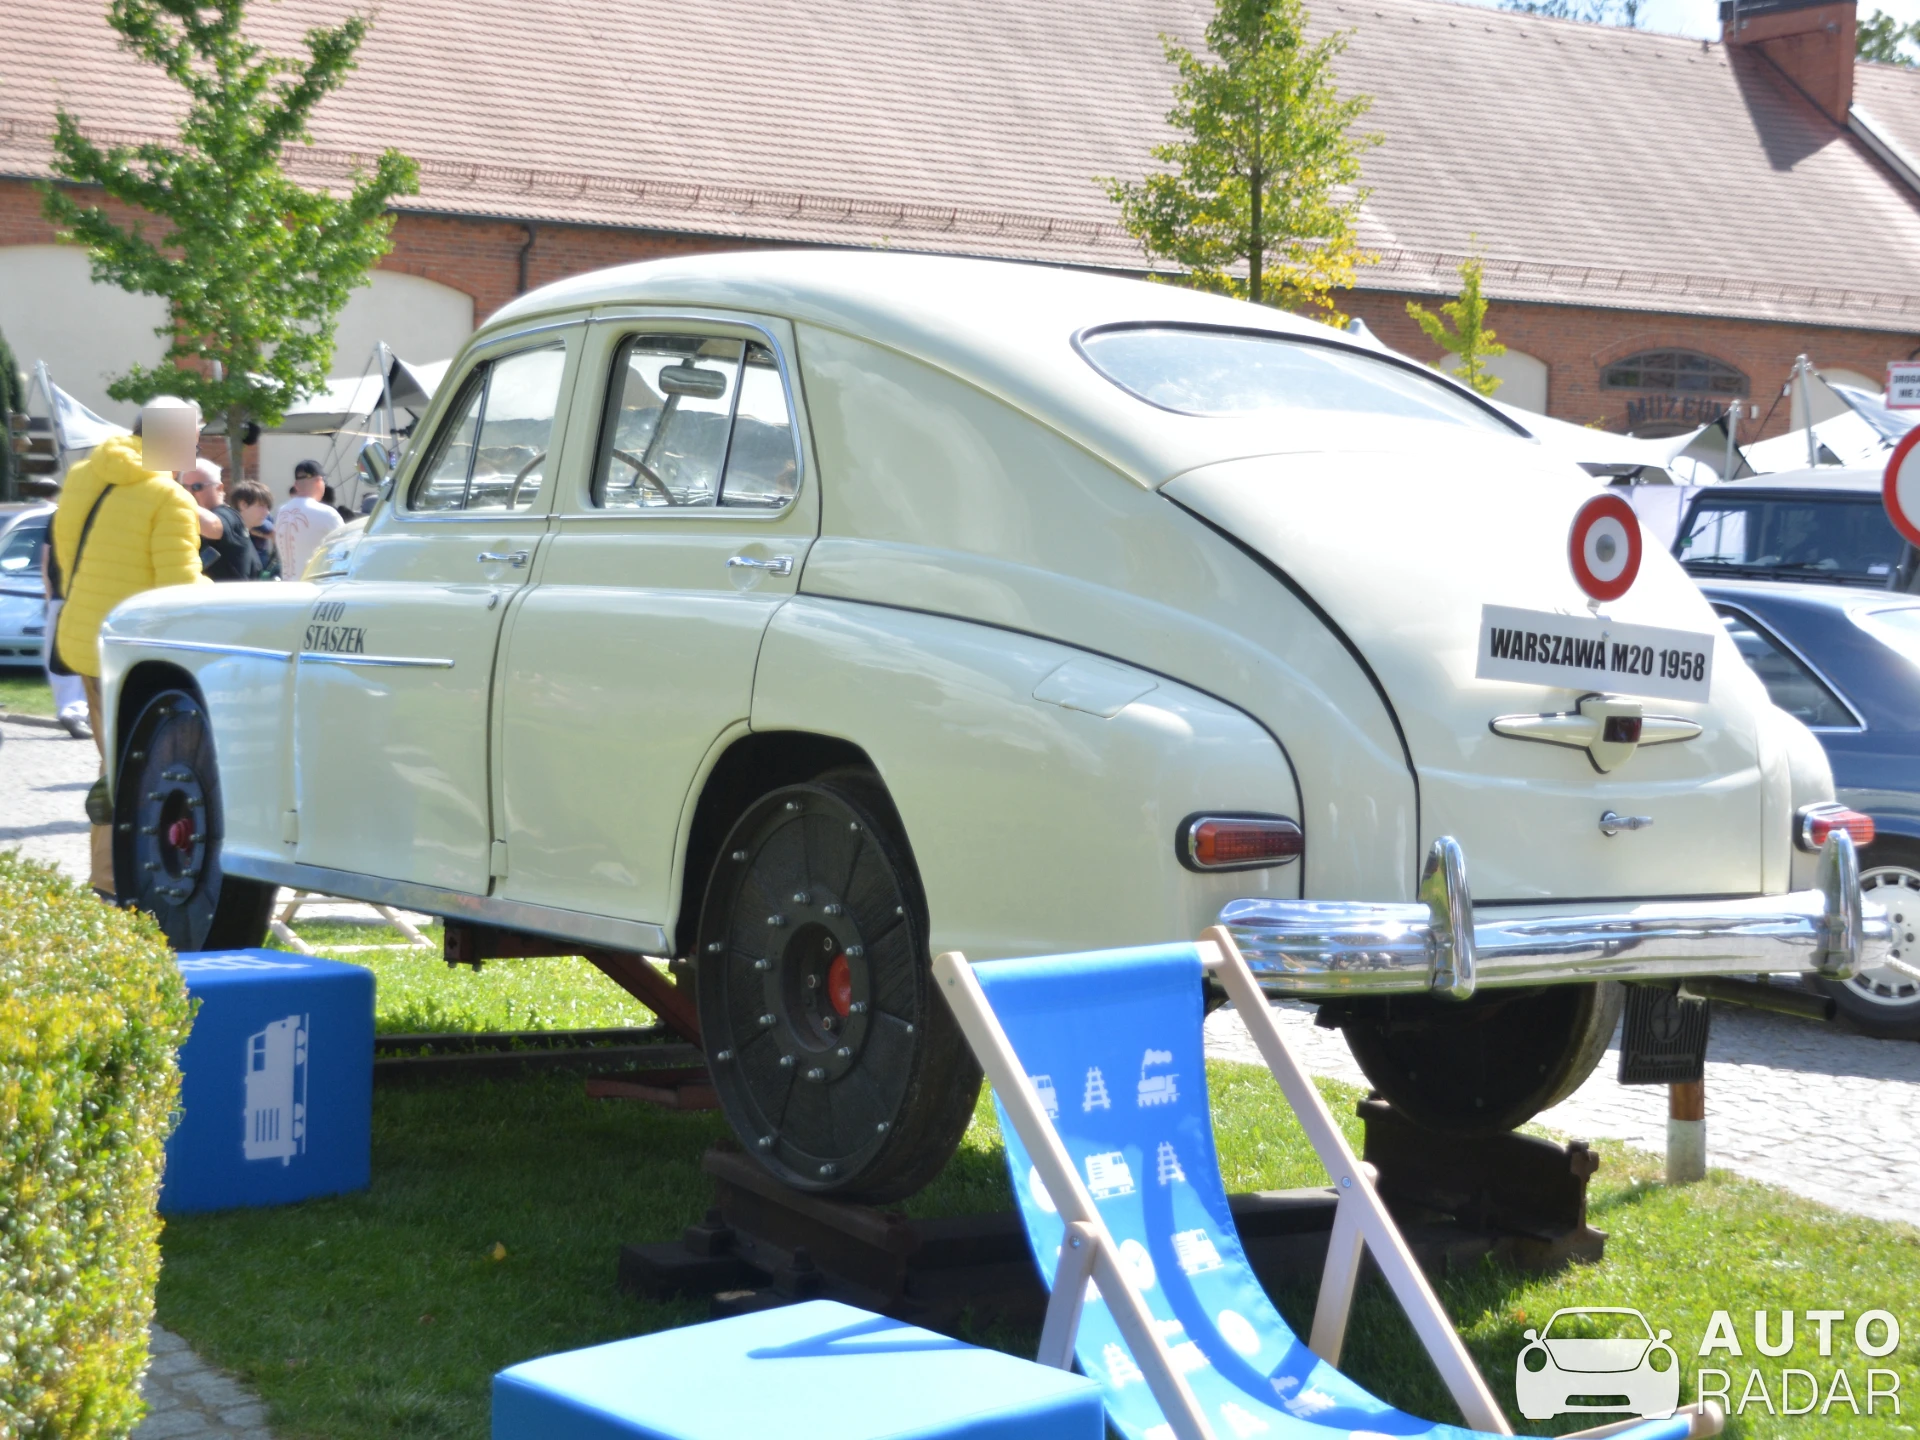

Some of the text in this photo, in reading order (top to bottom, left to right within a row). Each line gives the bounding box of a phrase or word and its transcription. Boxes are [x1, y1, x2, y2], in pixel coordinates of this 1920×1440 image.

[312, 601, 346, 622] TATO
[303, 624, 368, 653] STASZEK
[1490, 627, 1706, 682] WARSZAWA M20 1958
